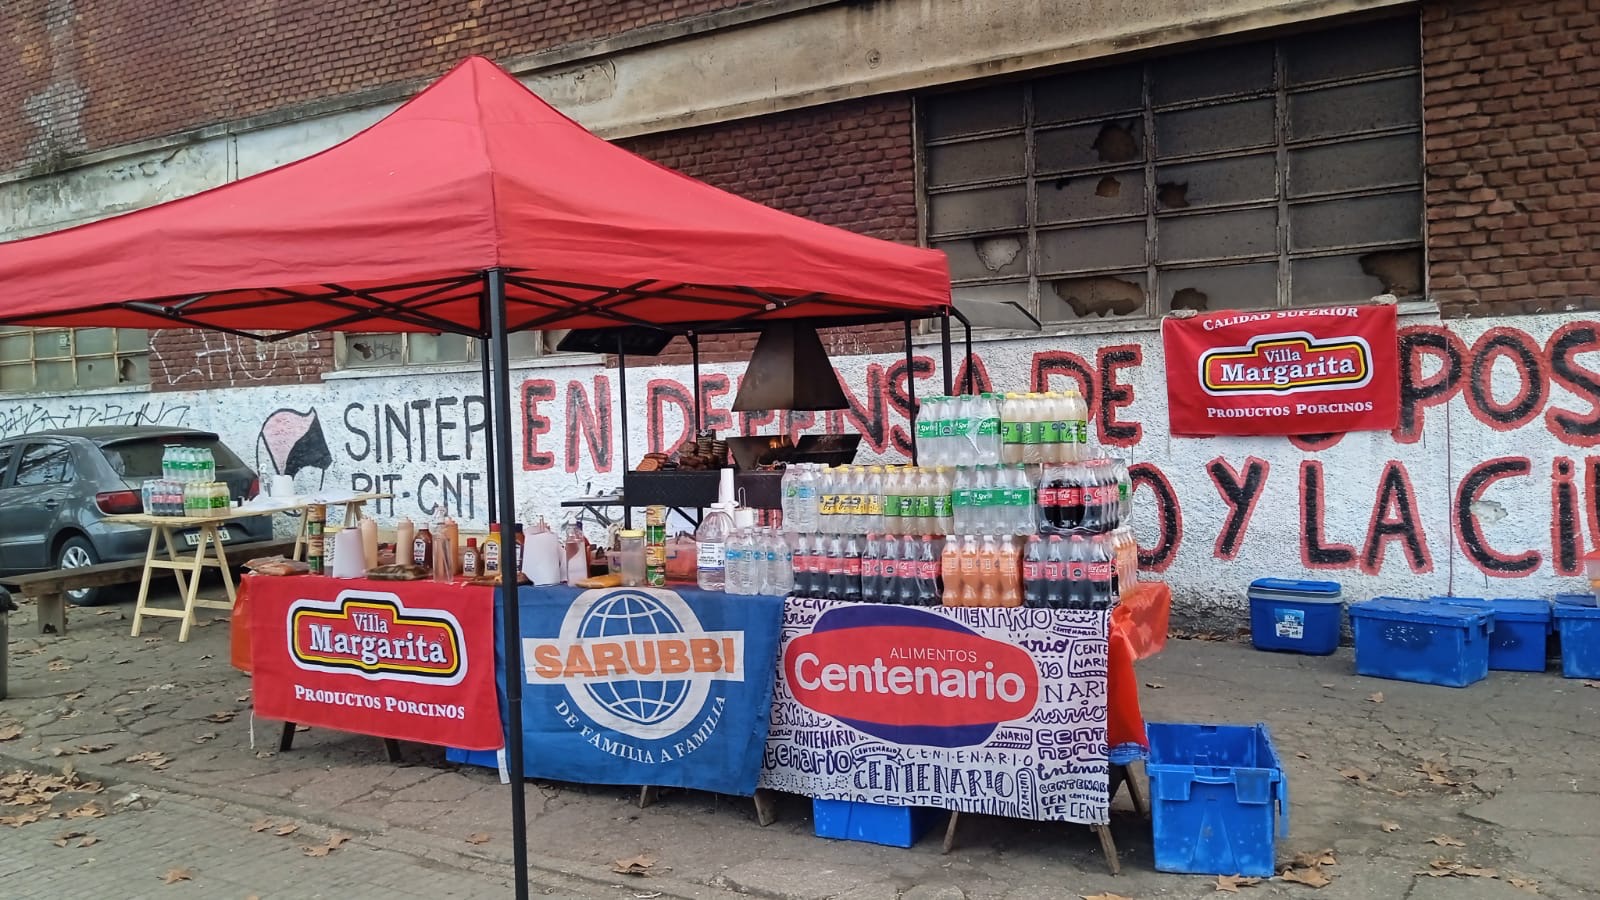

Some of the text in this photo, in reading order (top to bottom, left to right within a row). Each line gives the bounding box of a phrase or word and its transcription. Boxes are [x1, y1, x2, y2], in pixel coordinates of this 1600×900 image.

[1203, 312, 1271, 331] CALIDAD
[1221, 357, 1356, 385] Margarita
[1264, 348, 1302, 363] Villa
[521, 375, 613, 473] EN
[1207, 402, 1373, 418] PRODUCTOS PORCINOS
[343, 395, 487, 464] SINTEP
[352, 472, 481, 519] PIT-CNT
[352, 613, 389, 634] Villa
[309, 623, 448, 665] Margarita
[534, 637, 735, 679] SARUBBI
[889, 647, 978, 664] ALIMENTOS
[794, 652, 1026, 703] Centenario
[294, 684, 466, 720] PRODUCTOS PORCINOS
[555, 696, 726, 764] DE FAMILIA A FAMILIA
[853, 760, 1014, 798] CENTENARIO
